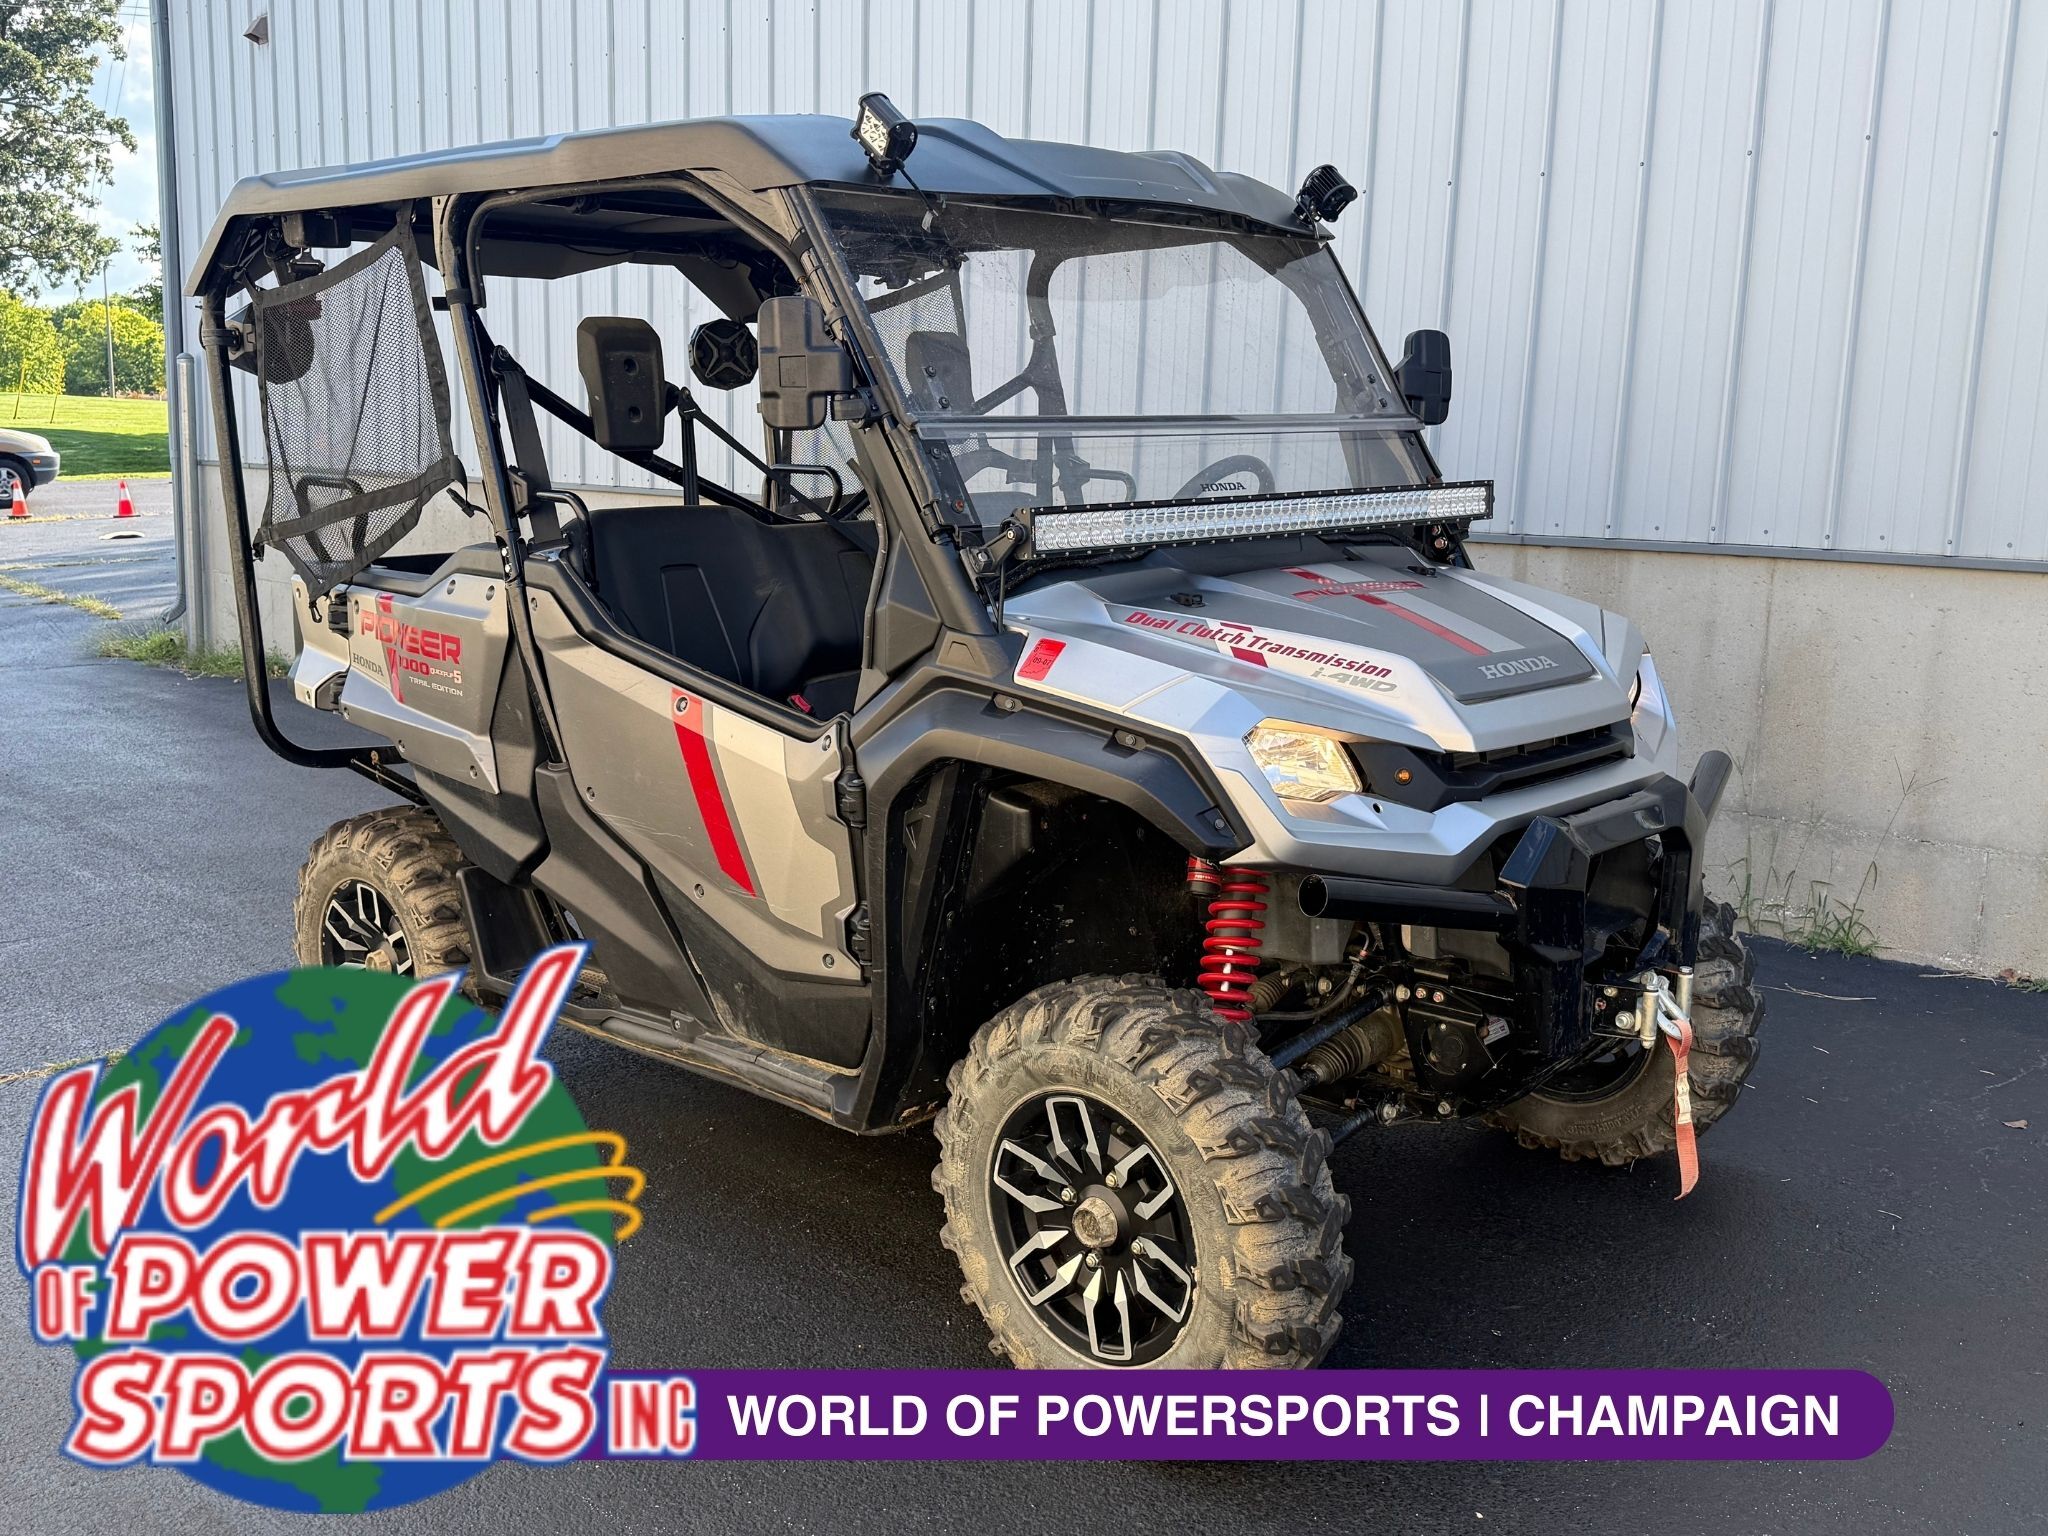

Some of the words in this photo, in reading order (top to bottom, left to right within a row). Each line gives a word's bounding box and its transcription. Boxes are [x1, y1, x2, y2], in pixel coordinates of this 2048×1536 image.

[1200, 482, 1247, 492] HONDA
[1124, 611, 1178, 630] Dual
[1176, 621, 1246, 645] Clutch
[1247, 635, 1393, 678] Transmission
[353, 652, 385, 677] HONDA
[1477, 655, 1560, 680] HONDA
[408, 676, 431, 688] TRAIL
[431, 683, 463, 697] EDITION
[1310, 667, 1398, 693] i-4WD
